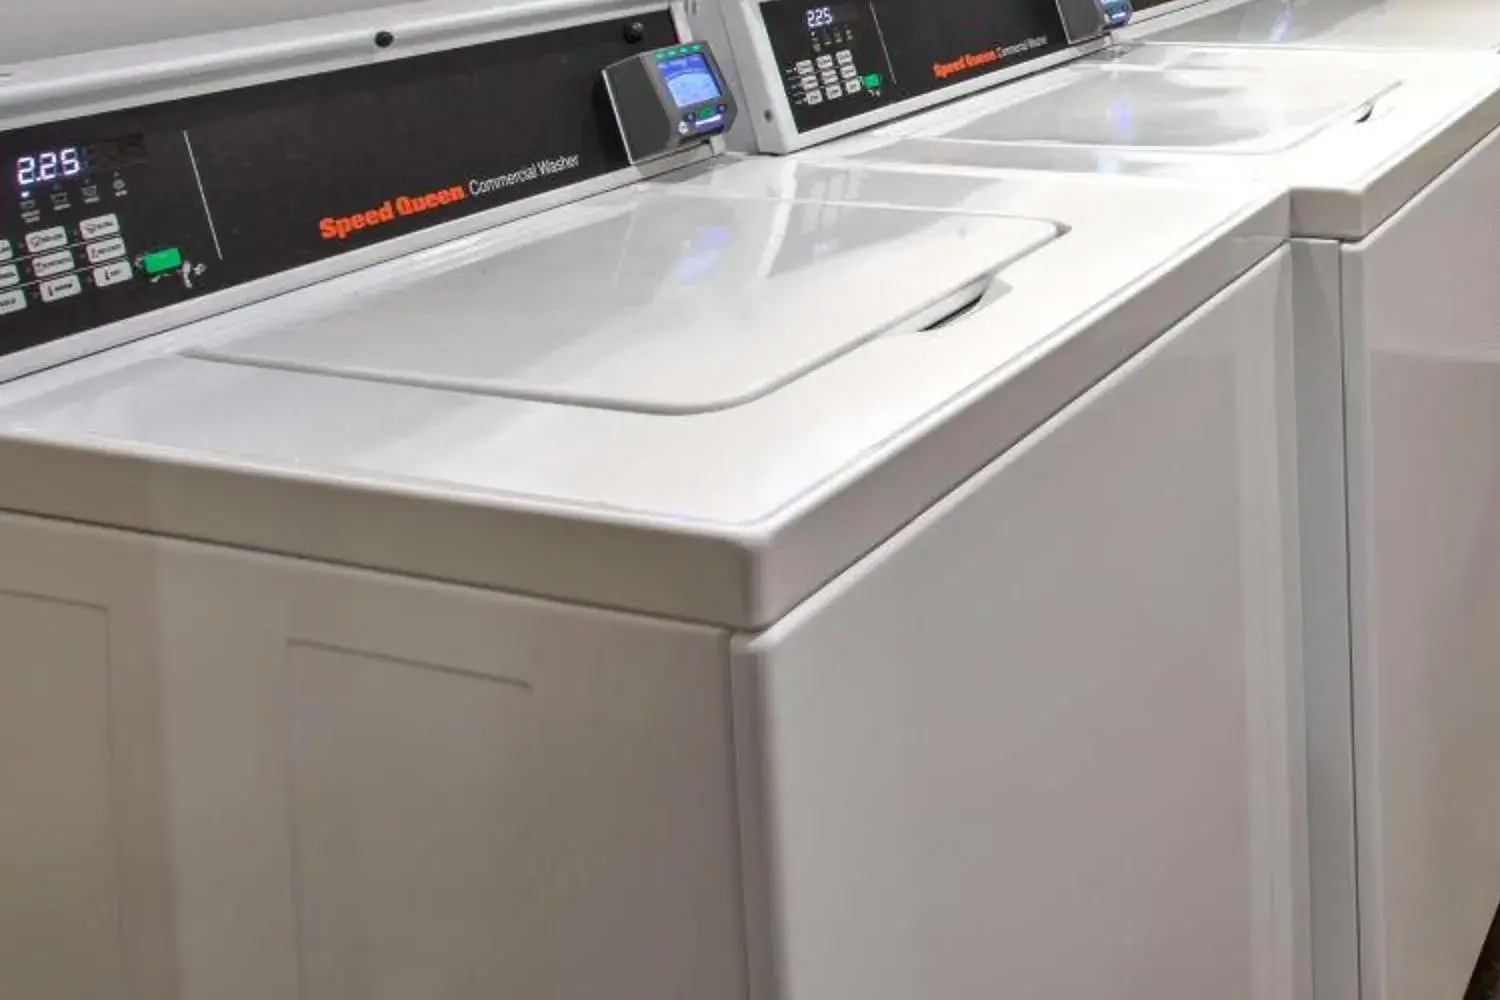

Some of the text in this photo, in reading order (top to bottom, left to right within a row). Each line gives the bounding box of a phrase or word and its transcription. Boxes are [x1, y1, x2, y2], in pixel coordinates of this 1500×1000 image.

[319, 154, 580, 239] Speed Queen Commercial Washer
